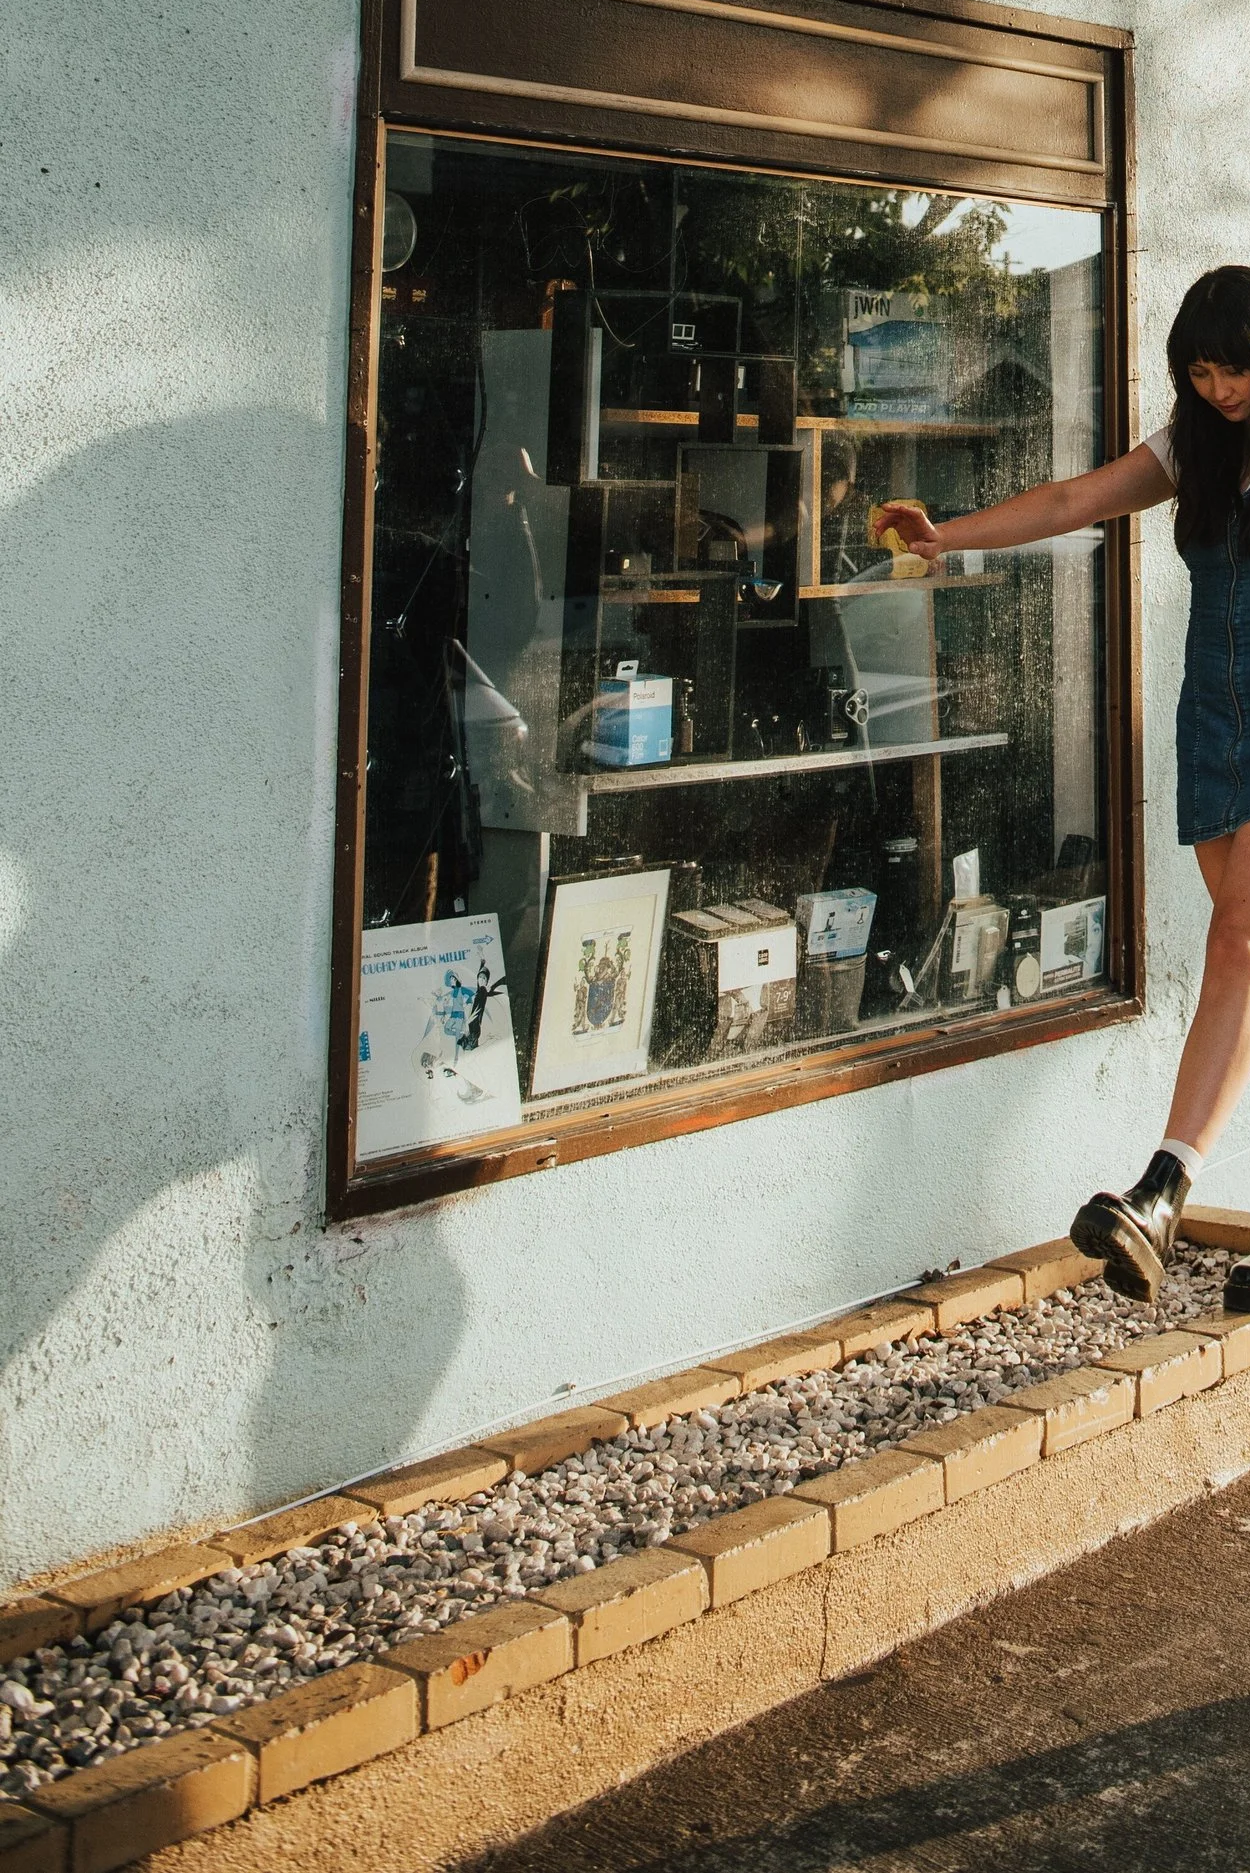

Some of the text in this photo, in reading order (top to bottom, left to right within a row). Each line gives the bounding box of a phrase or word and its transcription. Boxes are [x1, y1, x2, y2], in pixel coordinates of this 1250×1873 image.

[854, 402, 878, 413] DVD
[633, 690, 656, 701] Polaroid
[469, 918, 492, 926] STEREO
[410, 945, 428, 953] ALBUM
[400, 954, 437, 970] MODERN
